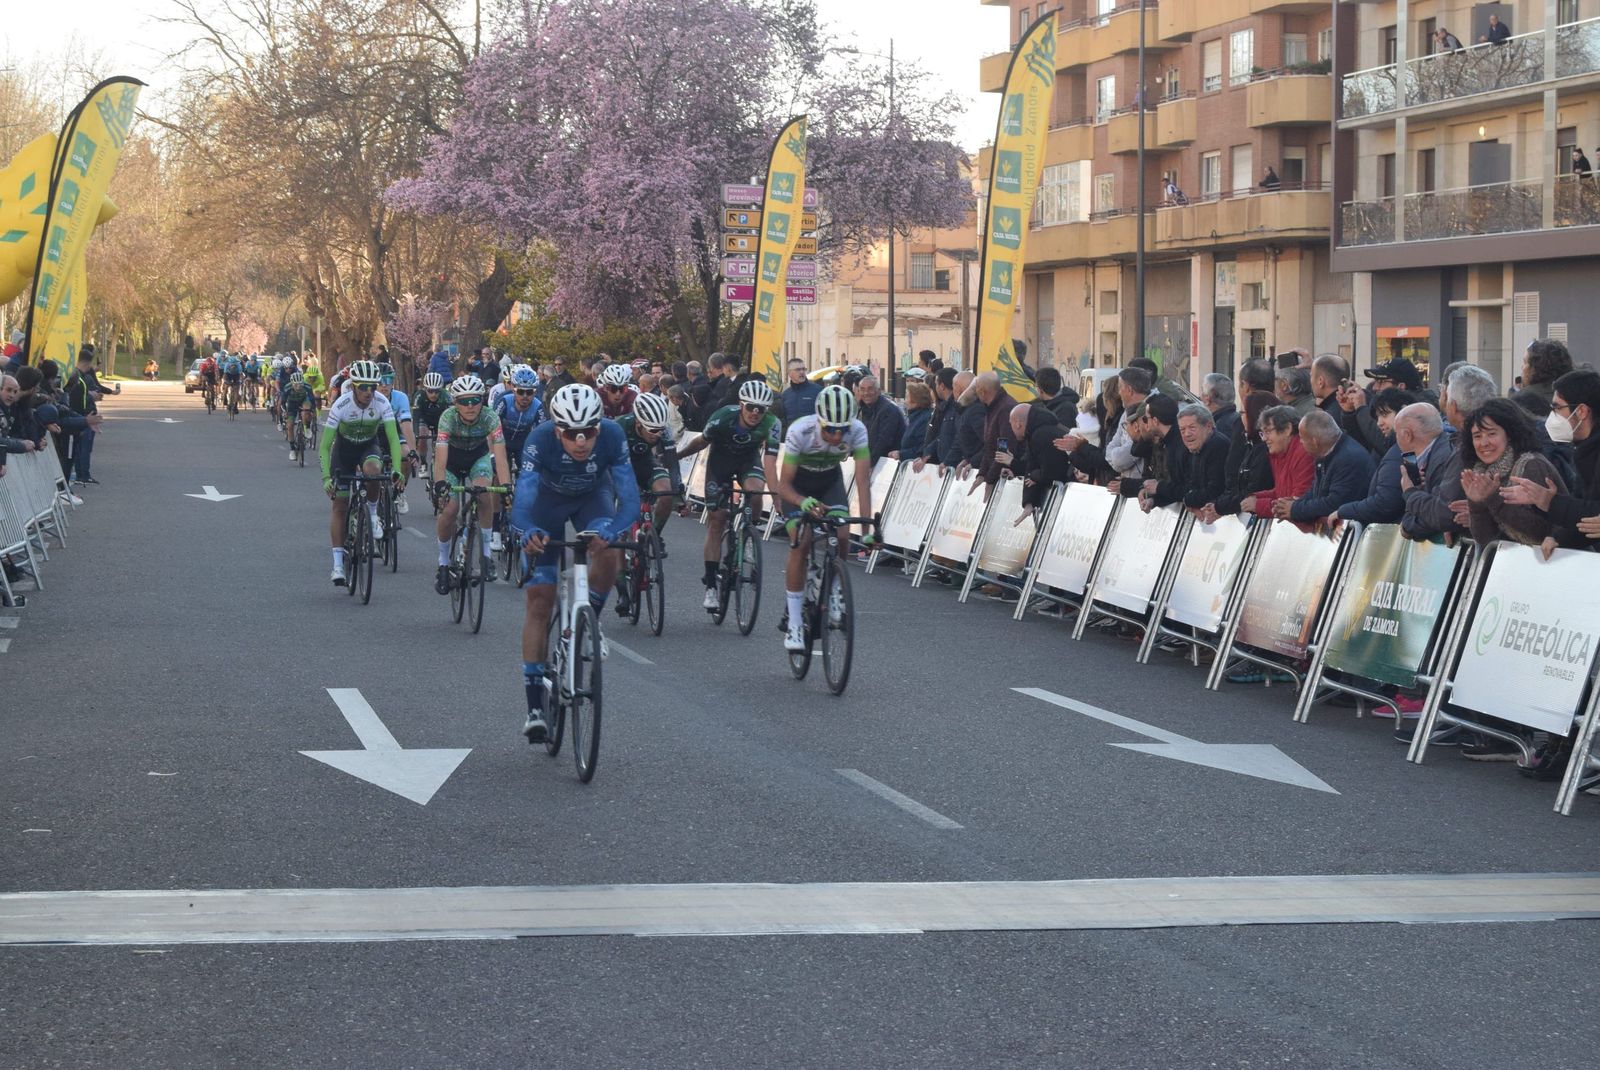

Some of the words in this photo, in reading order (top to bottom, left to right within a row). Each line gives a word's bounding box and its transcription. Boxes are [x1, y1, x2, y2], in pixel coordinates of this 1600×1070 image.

[1024, 145, 1035, 211] Valladolid
[728, 194, 761, 203] provincia
[1371, 581, 1394, 609] CAJA
[1393, 583, 1438, 617] RURAL
[1510, 601, 1530, 615] GRUPO
[1363, 616, 1373, 631] DE
[1371, 617, 1399, 637] ZAMORA
[1499, 617, 1591, 666] IBEREÓLICA
